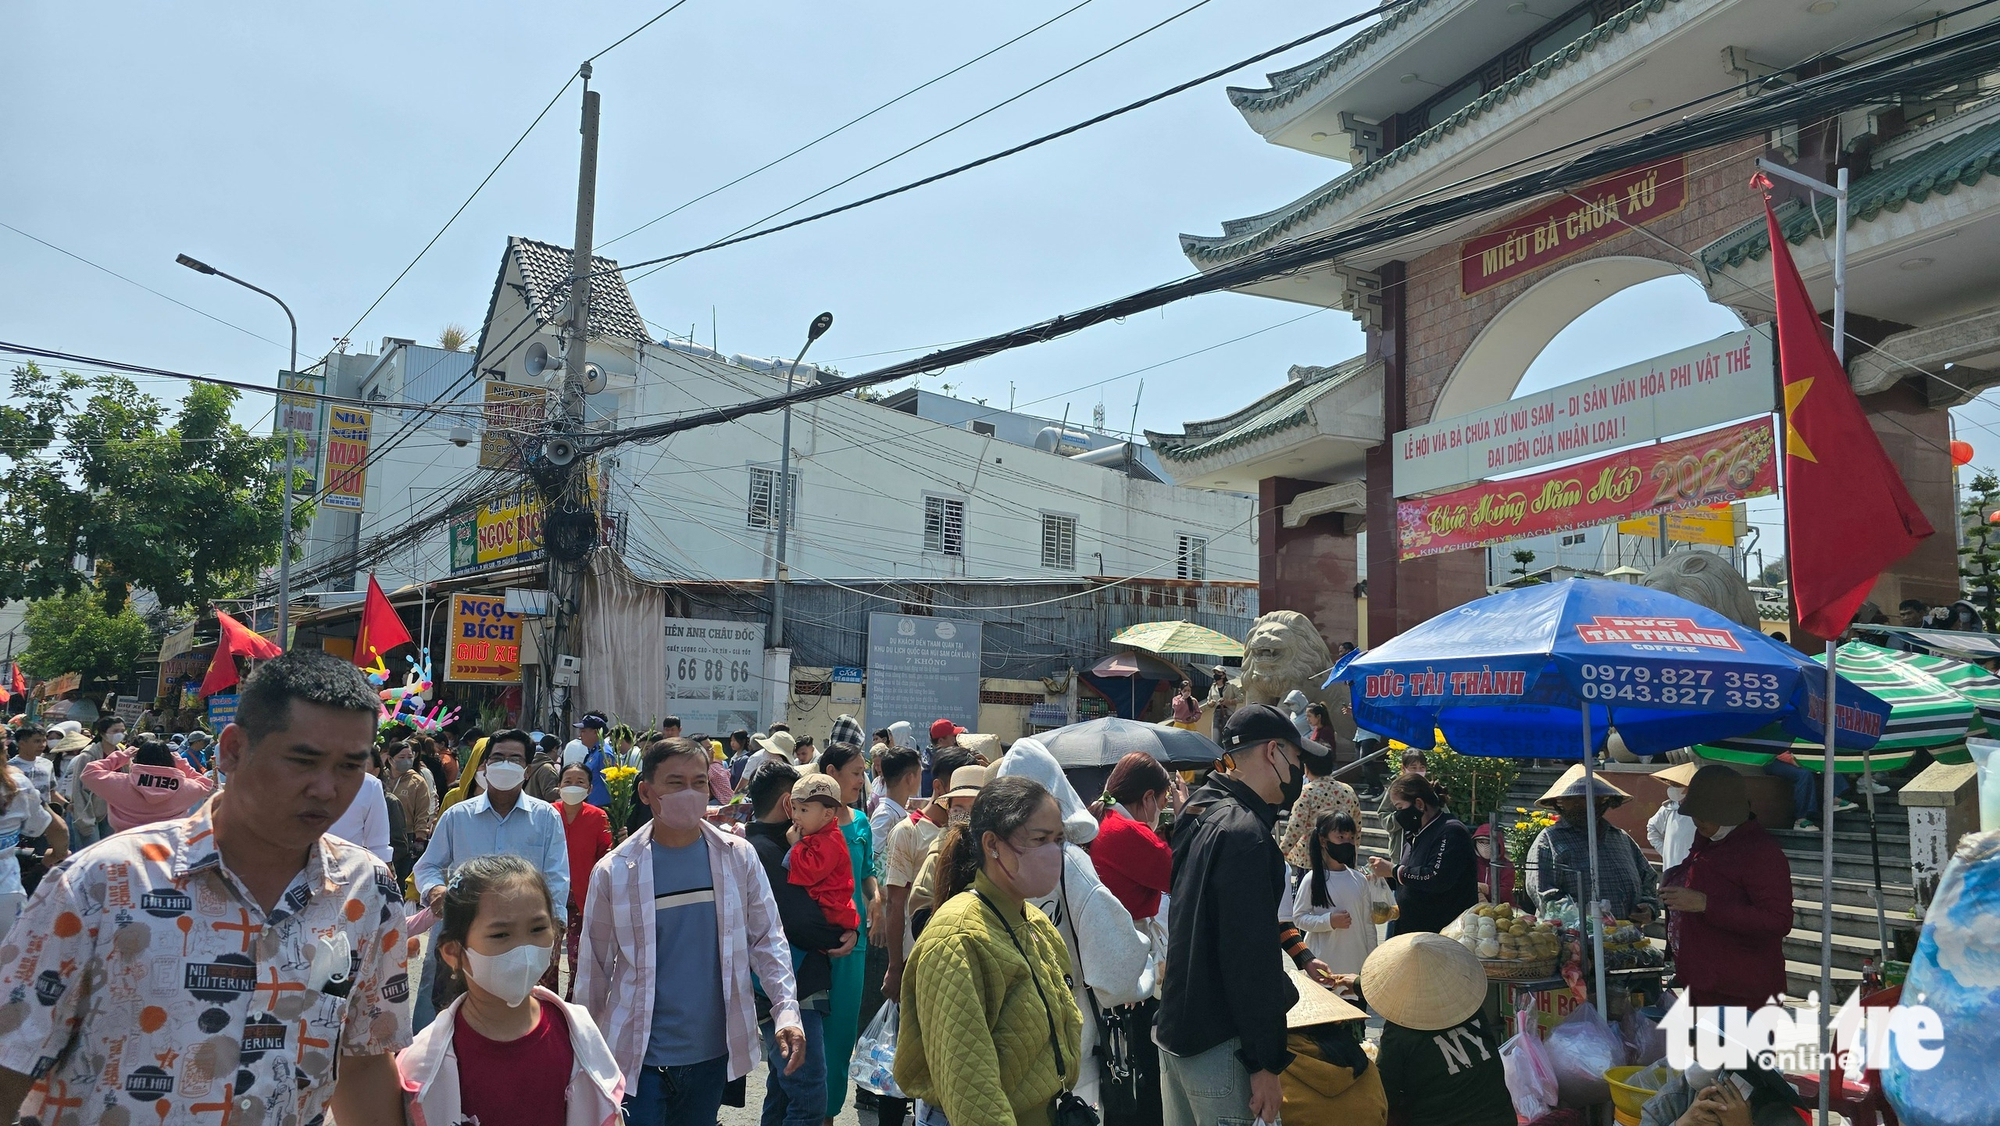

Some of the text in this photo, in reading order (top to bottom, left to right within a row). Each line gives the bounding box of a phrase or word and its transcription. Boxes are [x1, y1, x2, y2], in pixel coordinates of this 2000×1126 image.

[1482, 170, 1658, 277] MIẾU BÀ CHÚA XỨ
[1404, 434, 1414, 460] LỄ
[1416, 434, 1430, 460] HỘI
[1432, 429, 1448, 452] VÍA
[1450, 424, 1462, 448] BÀ
[1466, 416, 1490, 444] CHÚA
[1494, 410, 1508, 436] XỨ
[1511, 406, 1528, 432] NÚI
[1531, 402, 1554, 427] SAM
[1569, 396, 1580, 417] DI
[1583, 384, 1607, 413] SẢN
[1612, 377, 1636, 406] VĂN
[1640, 368, 1666, 398] HÓA
[1670, 364, 1691, 390] PHI
[1696, 352, 1720, 385] VẬT
[1726, 334, 1751, 374] THỂ
[328, 442, 366, 467] MAI
[1488, 448, 1504, 471] ĐẠI
[1508, 437, 1530, 465] DIỆN
[1533, 430, 1554, 457] CỦA
[1558, 422, 1589, 451] NHÂN
[1593, 418, 1618, 444] LOẠI
[330, 468, 362, 494] VUI
[1427, 441, 1756, 537] Chúc Mừng Năm Mới 2026
[478, 520, 514, 553] NGỌC
[1556, 524, 1572, 533] AN
[462, 618, 515, 640] BÍCH
[686, 628, 706, 638] ANH
[709, 627, 733, 639] CHÂU
[735, 628, 754, 641] ĐỐC
[890, 637, 896, 645] DU
[1586, 627, 1732, 648] TÀI THÀNH
[457, 640, 518, 662] GIỮ XE
[1631, 643, 1700, 653] COFFEE
[678, 658, 696, 680] 66
[705, 659, 722, 681] 88
[731, 660, 748, 682] 66
[914, 658, 947, 666] KHÔNG
[1366, 665, 1526, 698] ĐỨC TÀI THÀNH
[1581, 664, 1779, 690] 0979.827 353
[1582, 682, 1780, 709] 0943.827 353
[1835, 702, 1881, 738] THÀNH
[137, 774, 179, 790] GELIN
[1433, 1019, 1491, 1076] NY
